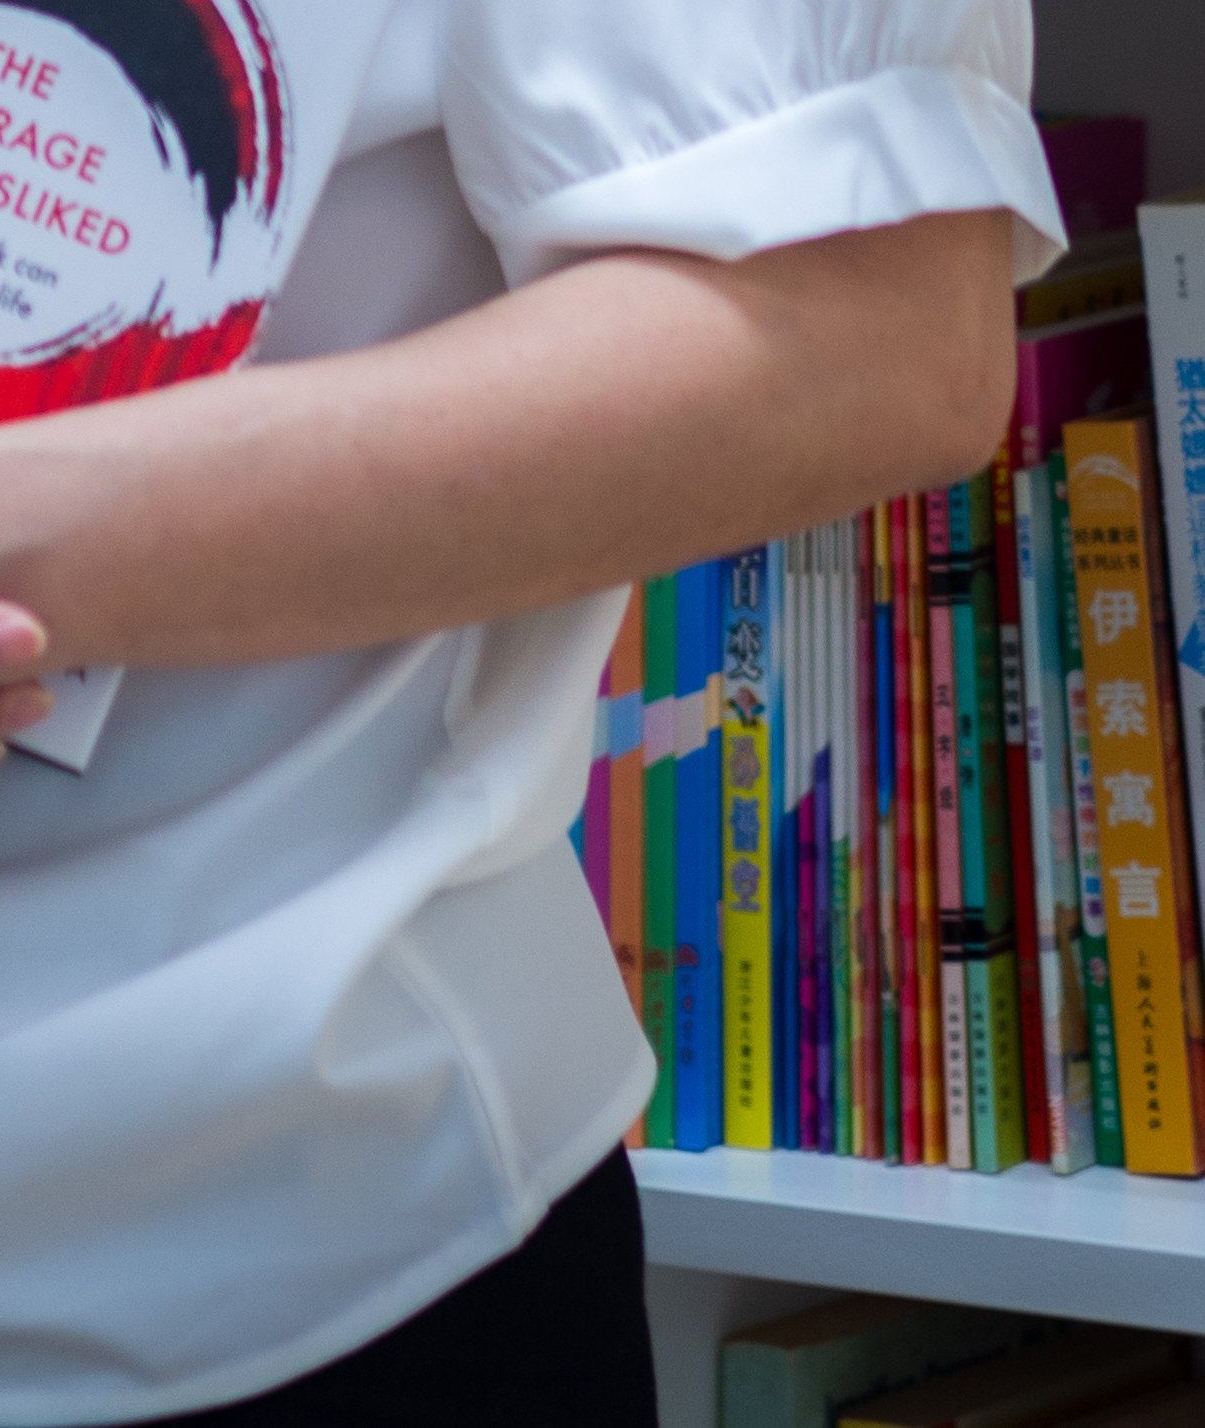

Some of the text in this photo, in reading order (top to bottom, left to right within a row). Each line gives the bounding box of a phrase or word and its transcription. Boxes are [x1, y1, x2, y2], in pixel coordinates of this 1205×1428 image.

[14, 257, 58, 288] can
[1086, 588, 1162, 920] 伊索寓言
